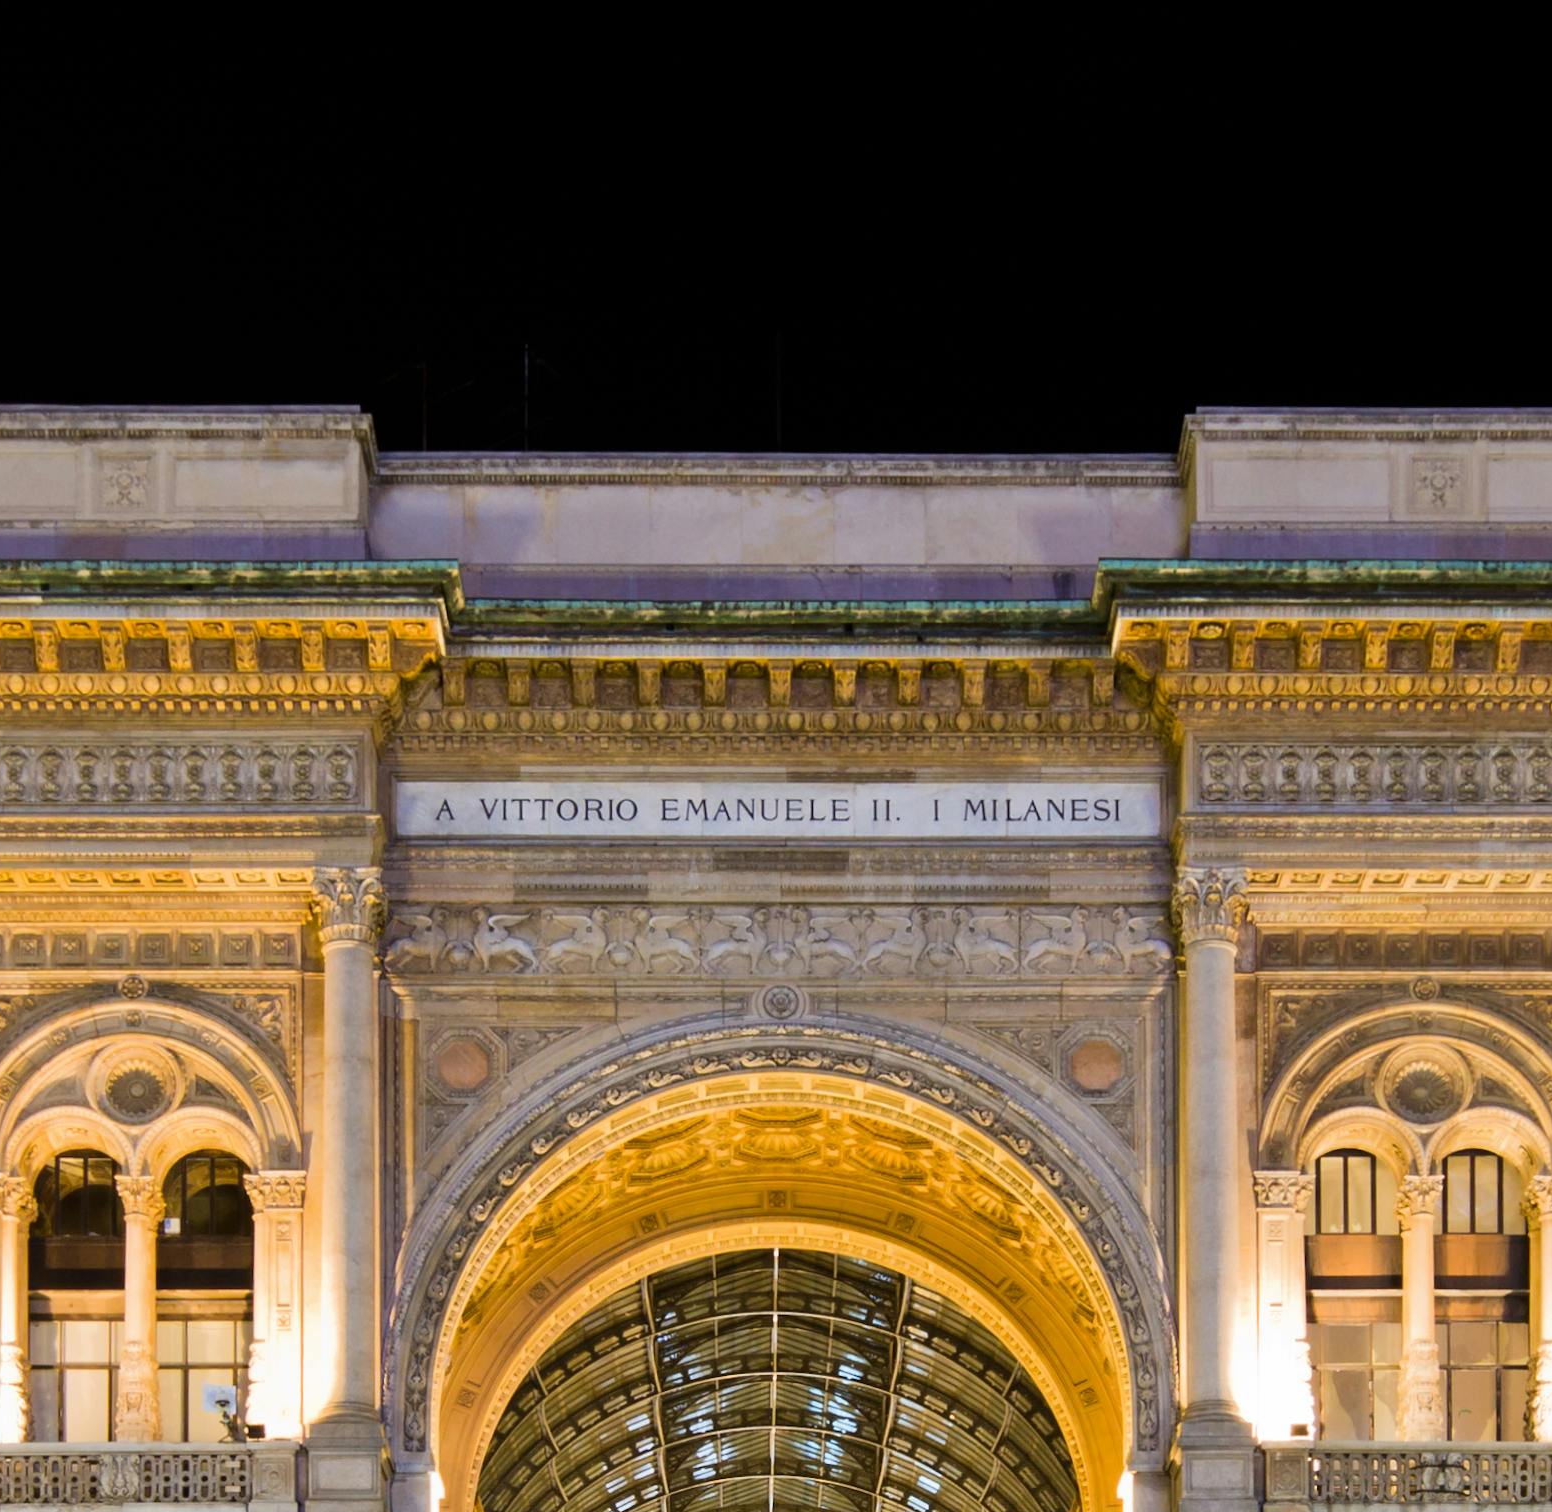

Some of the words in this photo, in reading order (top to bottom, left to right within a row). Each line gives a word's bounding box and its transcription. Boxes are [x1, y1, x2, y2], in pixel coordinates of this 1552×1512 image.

[434, 797, 456, 822] A
[479, 797, 639, 822] VITTORIO
[660, 797, 851, 822] EMANUELE
[872, 797, 901, 822] II.
[933, 797, 940, 822] I
[963, 797, 1121, 822] MILANESI
